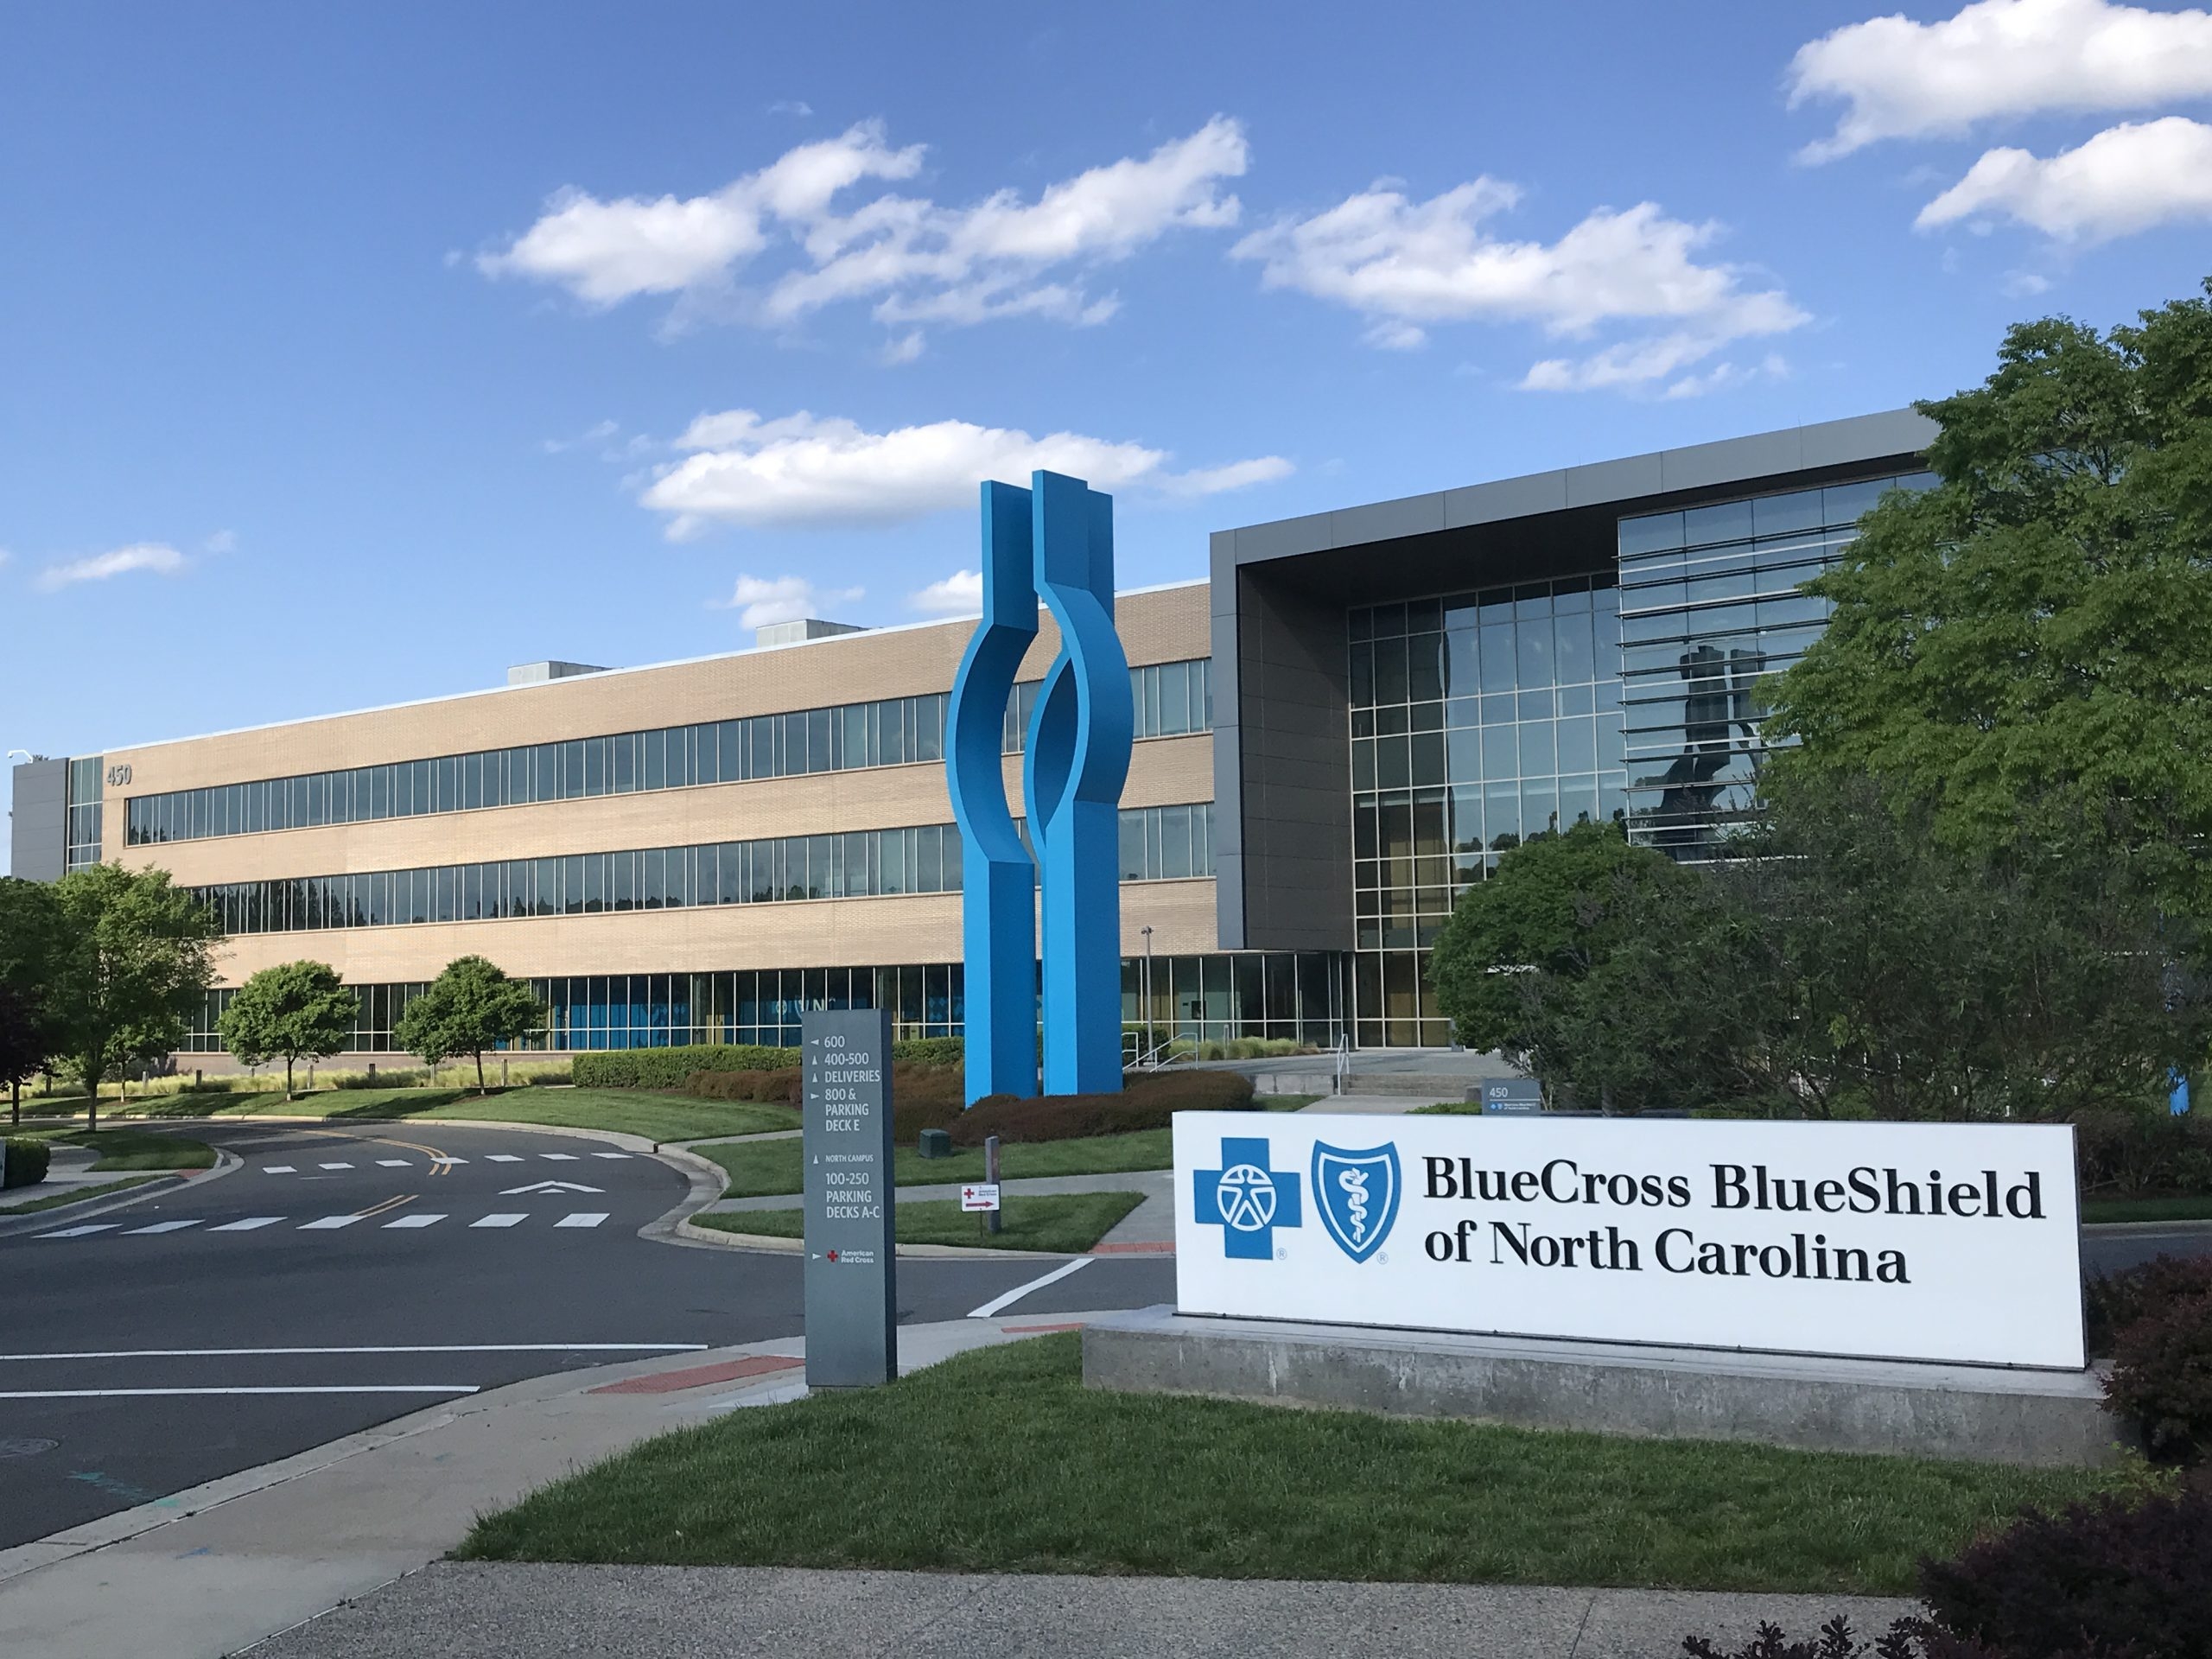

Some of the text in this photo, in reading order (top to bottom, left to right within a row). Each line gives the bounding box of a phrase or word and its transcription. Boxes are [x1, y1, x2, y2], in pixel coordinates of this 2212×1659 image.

[107, 765, 132, 786] 450
[824, 1036, 845, 1048] 600
[824, 1052, 869, 1065] 400-500
[824, 1070, 881, 1083] DELIVERIES
[825, 1088, 856, 1101] 800 &
[1489, 1087, 1509, 1098] 450
[825, 1103, 869, 1116] PARKING
[826, 1119, 861, 1132] DECK E
[825, 1154, 874, 1163] NORTH CAMPUS
[825, 1173, 869, 1185] 100-250
[1421, 1156, 2047, 1219] BlueCross BlueShield
[826, 1190, 873, 1203] PARKING
[826, 1205, 880, 1218] DECKS A-C
[1425, 1219, 1912, 1284] of North Carolina
